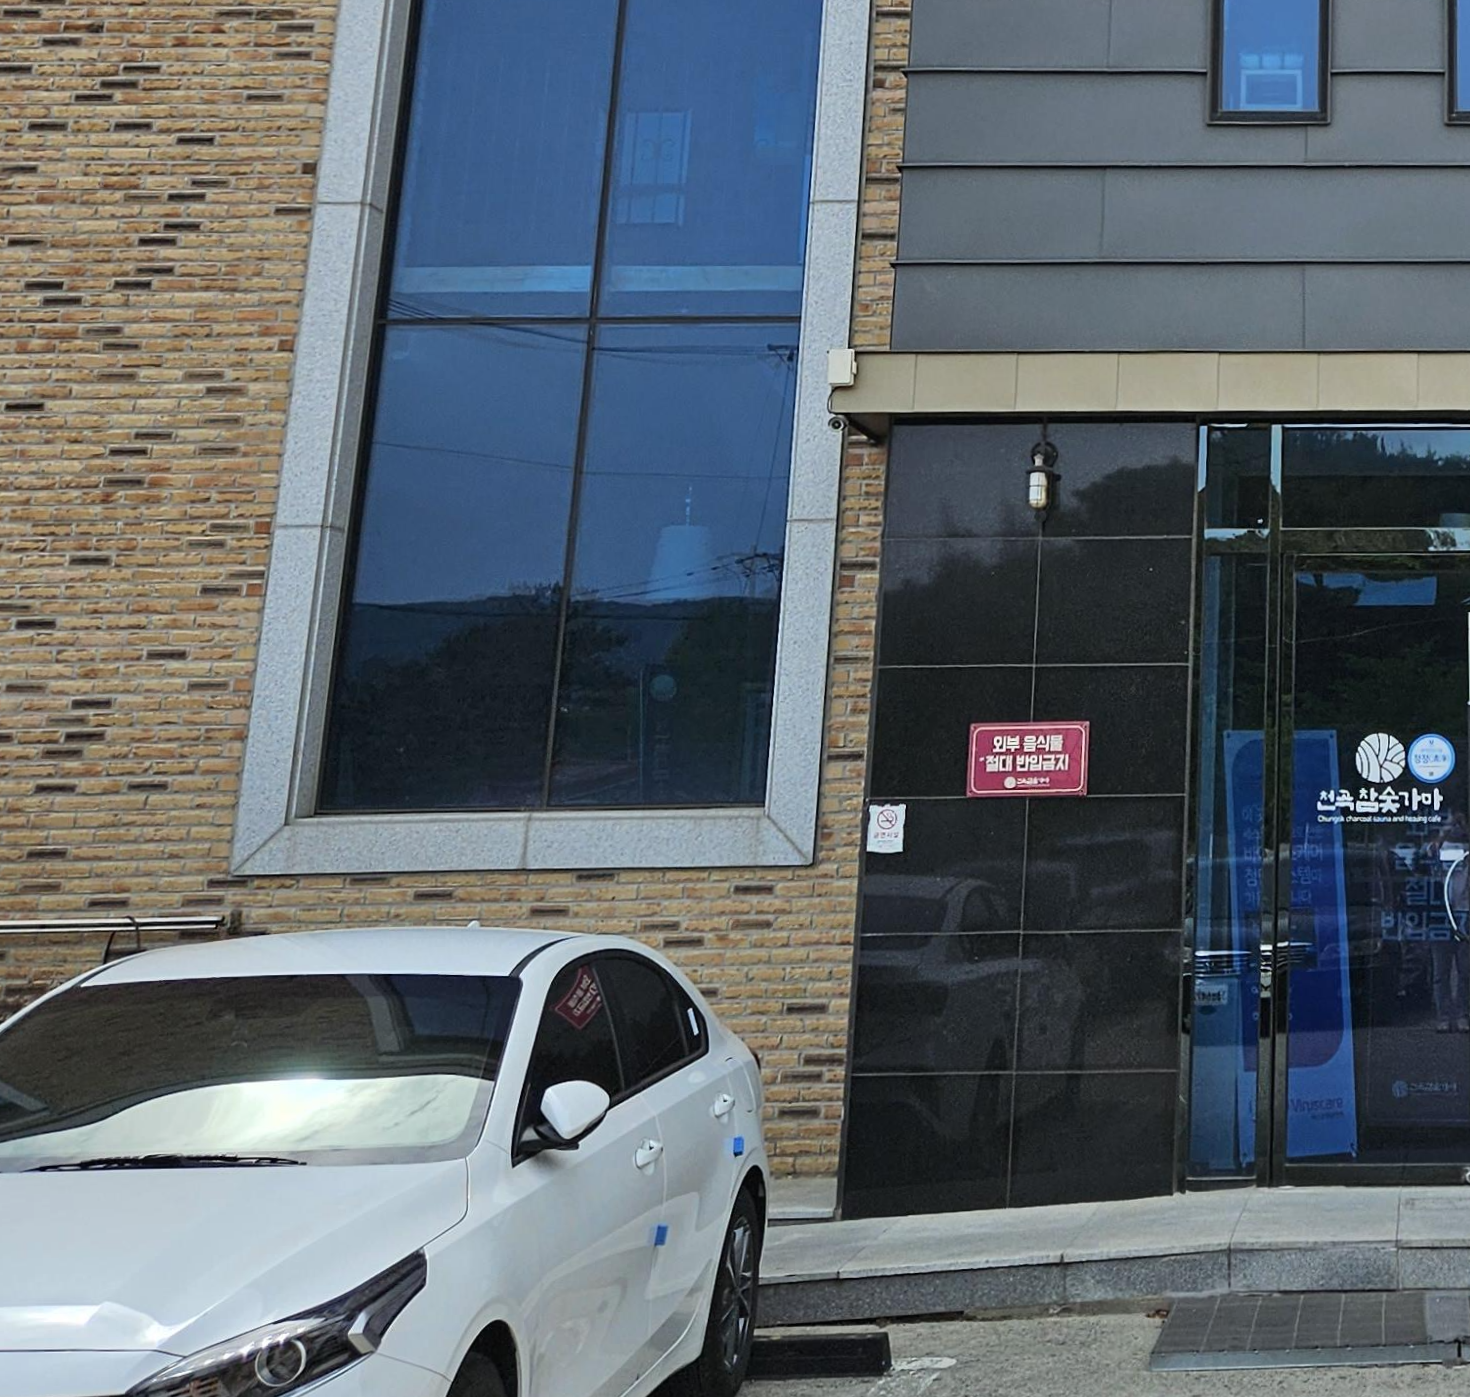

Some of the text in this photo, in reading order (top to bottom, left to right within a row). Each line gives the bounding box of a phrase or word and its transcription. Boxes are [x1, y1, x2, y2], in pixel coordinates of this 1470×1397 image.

[993, 734, 1063, 753] 외부 음식물
[985, 754, 1069, 772] 절대 반입금지
